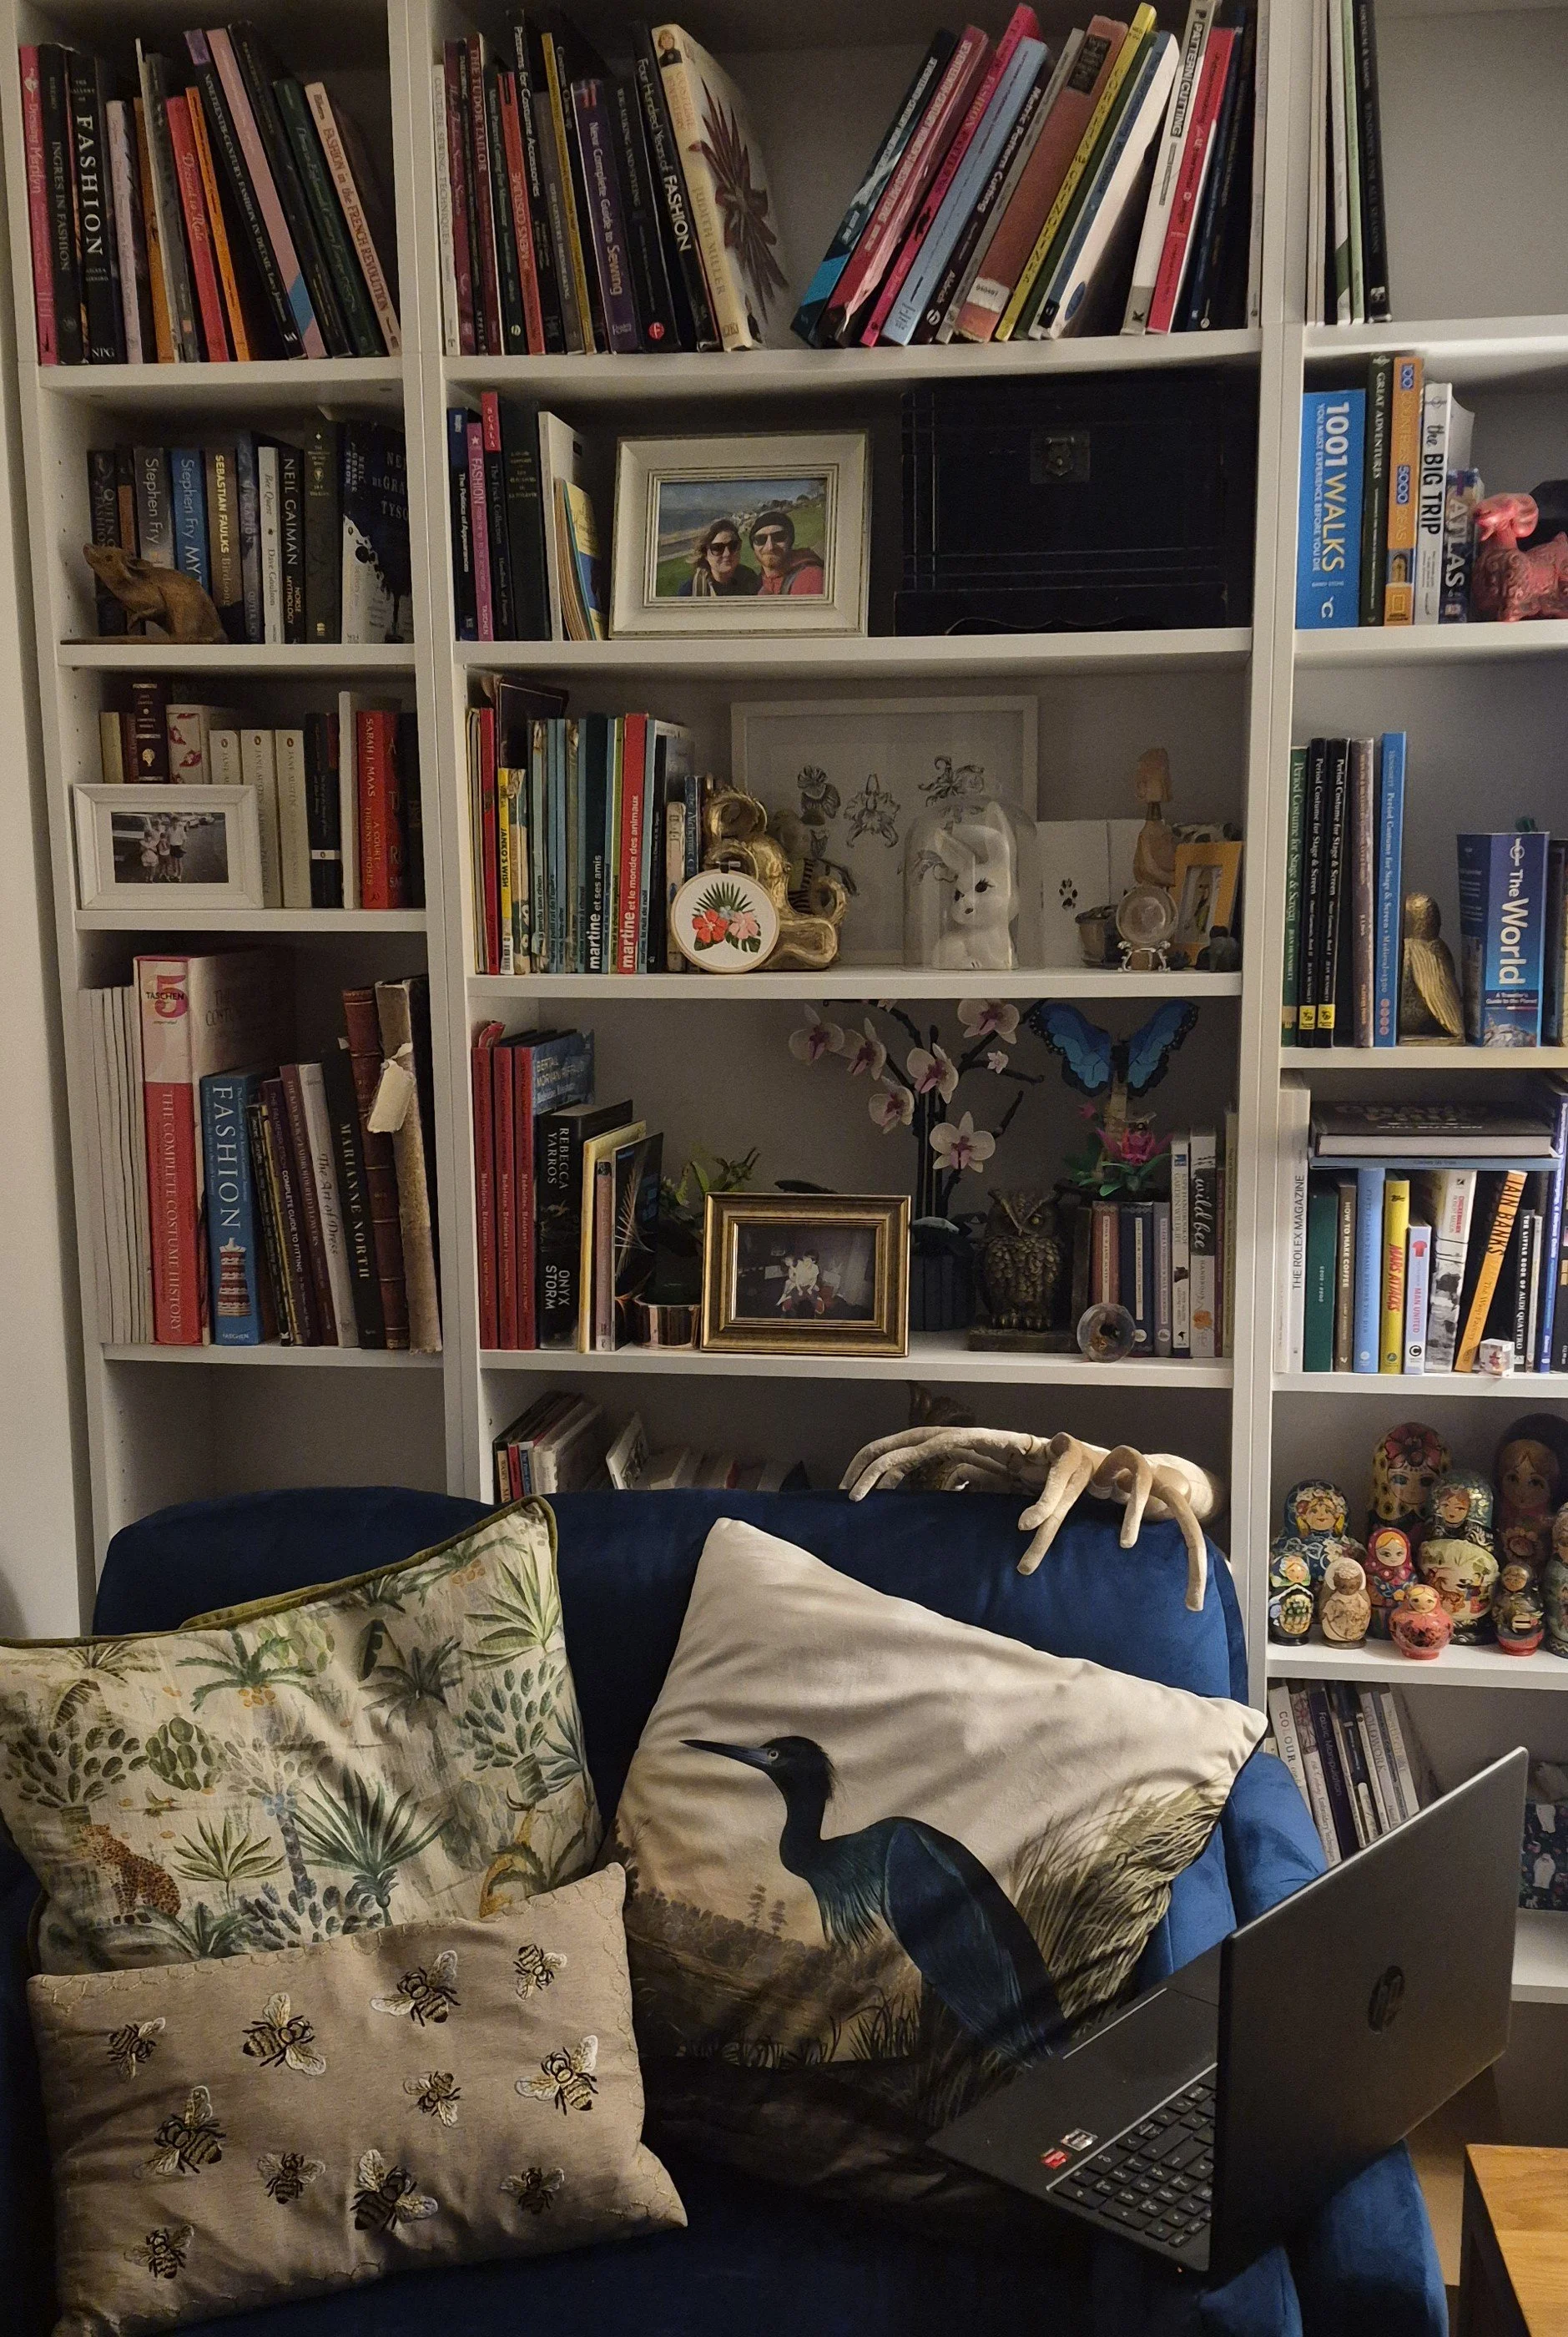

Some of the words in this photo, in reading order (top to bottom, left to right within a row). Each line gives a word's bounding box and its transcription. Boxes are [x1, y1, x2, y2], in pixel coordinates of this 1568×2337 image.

[470, 49, 480, 73] THE
[514, 26, 524, 69] Patterns
[1186, 22, 1203, 82] PATTERN
[519, 72, 528, 87] for
[637, 58, 653, 83] Four
[472, 78, 483, 121] TUDOR
[522, 88, 532, 134] Costume
[643, 82, 663, 132] Hundred
[1019, 86, 1042, 123] Metric
[1170, 81, 1192, 138] CUTTING
[476, 126, 487, 173] TAILOR
[589, 122, 599, 146] New
[653, 129, 668, 165] Years
[1001, 125, 1024, 168] Pattern
[52, 142, 64, 190] INGRES
[527, 138, 540, 197] Accessories
[593, 149, 608, 197] Complete
[662, 160, 673, 173] of
[56, 195, 66, 208] IN
[76, 115, 103, 255] FASHION
[978, 170, 1003, 213] Cutting
[600, 199, 613, 229] Guide
[663, 174, 692, 251] FASHION
[57, 214, 70, 271] FASHION
[604, 231, 613, 243] to
[607, 245, 623, 295] Sewing
[704, 236, 726, 295] MILLER
[1375, 372, 1386, 412] GREAT
[1401, 364, 1414, 390] 100
[487, 406, 496, 448] SCALA
[1316, 403, 1325, 423] YOU
[1315, 424, 1324, 448] MUST
[1325, 401, 1350, 466] 1001
[1373, 412, 1385, 479] ADVENTURES
[1426, 424, 1444, 447] the
[144, 457, 159, 517] Stephen
[214, 454, 227, 508] SEBASTIAN
[284, 458, 296, 493] NEIL
[471, 457, 485, 504] FASHION
[1314, 451, 1325, 501] EXPERIENCE
[1397, 465, 1410, 504] 5000
[1424, 453, 1444, 490] BIG
[265, 490, 274, 515] Quest
[1313, 502, 1323, 534] BEFORE
[1420, 492, 1443, 535] TRIP
[145, 521, 164, 544] Fry
[218, 511, 229, 553] FAULKS
[285, 499, 298, 565] GAIMAN
[1321, 472, 1347, 572] WALKS
[1396, 506, 1409, 541] IDEAS
[1313, 537, 1321, 556] YOU
[1444, 499, 1469, 588] ATLAS
[268, 572, 277, 607] Goulson
[481, 605, 491, 635] TASCHEN
[1293, 762, 1303, 793] Period
[1336, 759, 1344, 785] Period
[288, 775, 297, 807] AUSTEN
[1334, 786, 1344, 822] Costume
[364, 807, 373, 841] THORNS
[629, 795, 638, 838] animaux
[1292, 795, 1302, 837] Costume
[1333, 823, 1342, 835] for
[500, 827, 510, 863] JANKO'S
[1291, 839, 1300, 851] for
[1330, 835, 1341, 860] Stage
[502, 865, 510, 887] WISH
[593, 855, 602, 879] amis
[1288, 853, 1299, 876] Stage
[1329, 868, 1339, 896] Screen
[628, 891, 635, 900] le
[1289, 880, 1298, 889] &
[1509, 869, 1523, 896] The
[595, 901, 602, 911] et
[628, 901, 635, 911] et
[1288, 891, 1298, 921] Screen
[587, 913, 600, 970] martine
[621, 912, 635, 968] martine
[1499, 898, 1529, 984] World
[146, 992, 184, 1001] TASCHEN
[162, 1090, 174, 1119] THE
[164, 1123, 178, 1198] COMPLETE
[214, 1086, 241, 1229] FASHION
[317, 1153, 329, 1177] The
[547, 1133, 557, 1184] YARROS
[559, 1128, 569, 1189] REBECCA
[282, 1170, 293, 1208] COMPLETE
[320, 1184, 332, 1202] Art
[340, 1123, 361, 1214] MARIANNE
[353, 1221, 370, 1278] NORTH
[1196, 1178, 1212, 1221] wild
[1295, 1175, 1304, 1230] MAGAZINE
[1500, 1177, 1525, 1208] IAIN
[289, 1209, 297, 1231] GUIDE
[325, 1204, 340, 1219] of
[166, 1200, 179, 1269] COSTUME
[292, 1233, 299, 1242] TO
[325, 1221, 338, 1254] Dress
[1193, 1222, 1211, 1249] bee
[1344, 1224, 1351, 1235] TO
[1487, 1210, 1515, 1255] BANKS
[292, 1243, 302, 1272] FITTING
[1293, 1233, 1303, 1268] ROLEX
[1389, 1244, 1403, 1274] MARS
[545, 1264, 557, 1310] STORM
[558, 1269, 571, 1306] ONYX
[1293, 1269, 1302, 1290] THE
[1387, 1272, 1402, 1313] ATTACKS
[1484, 1281, 1493, 1295] The
[1520, 1278, 1526, 1290] OF
[169, 1271, 181, 1334] HISTORY
[1476, 1295, 1488, 1315] Wasp
[1518, 1290, 1526, 1310] AUDI
[1412, 1306, 1420, 1333] UNITED
[1468, 1315, 1482, 1341] Factory
[1516, 1311, 1525, 1350] QUATTRO
[1279, 1711, 1296, 1763] COLOUR
[1318, 1712, 1329, 1741] Fabric
[1325, 1740, 1343, 1797] Manipulation
